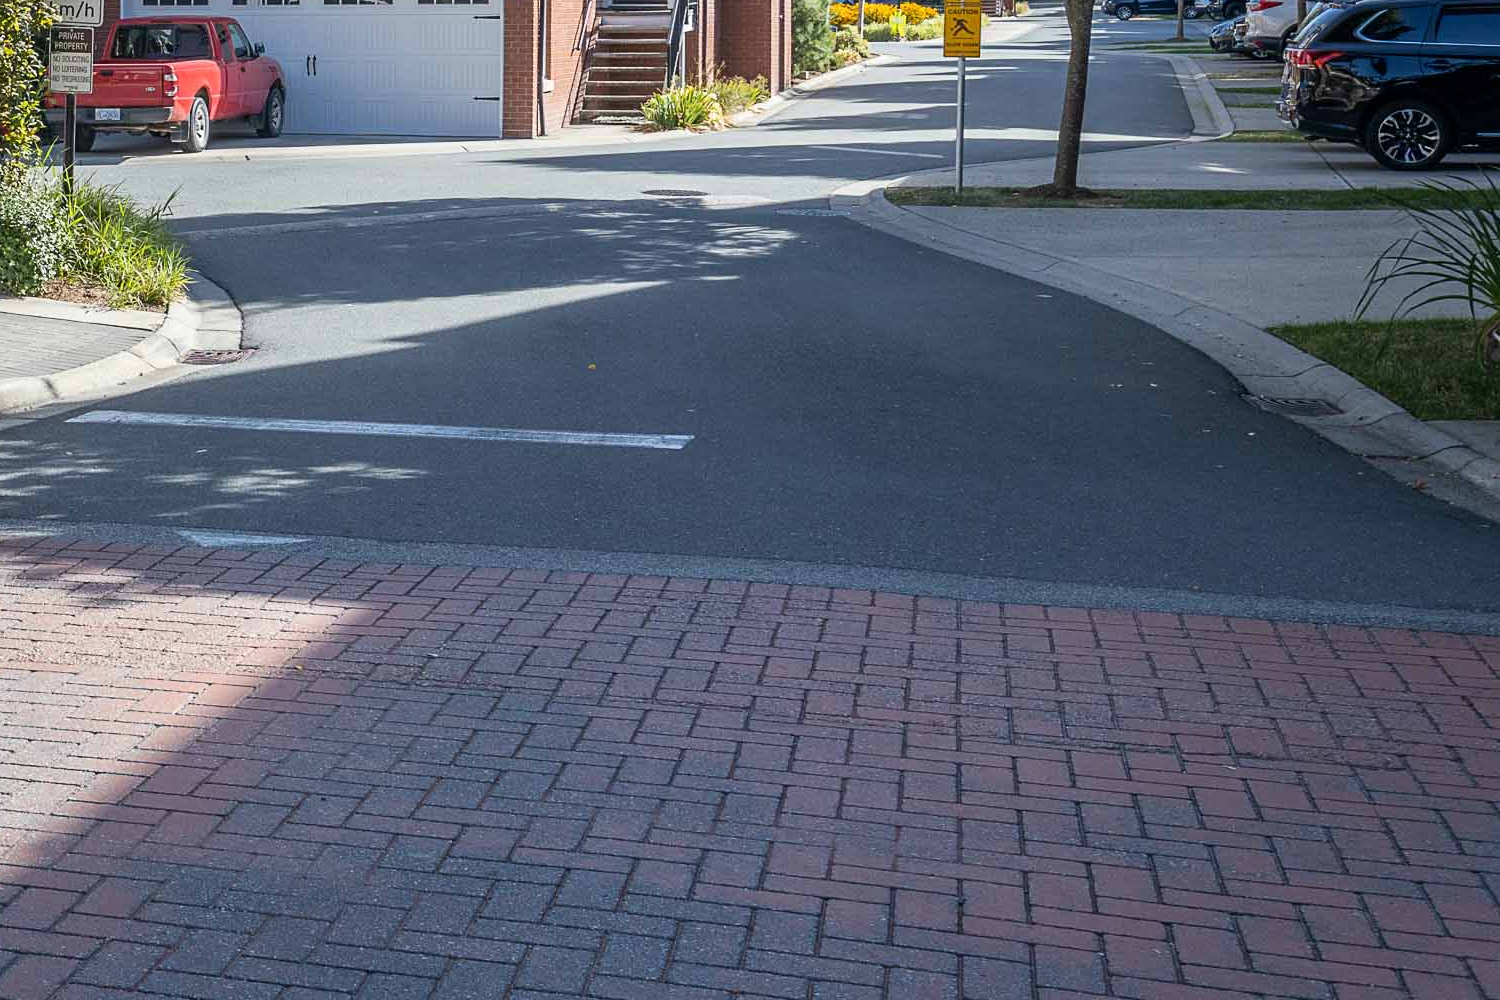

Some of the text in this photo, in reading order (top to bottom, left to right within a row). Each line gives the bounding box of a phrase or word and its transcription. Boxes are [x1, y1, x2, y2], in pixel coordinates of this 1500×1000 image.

[58, 31, 85, 41] PRIVATE
[54, 41, 89, 51] PROPERTY
[53, 55, 61, 63] NO
[52, 64, 60, 73] NO
